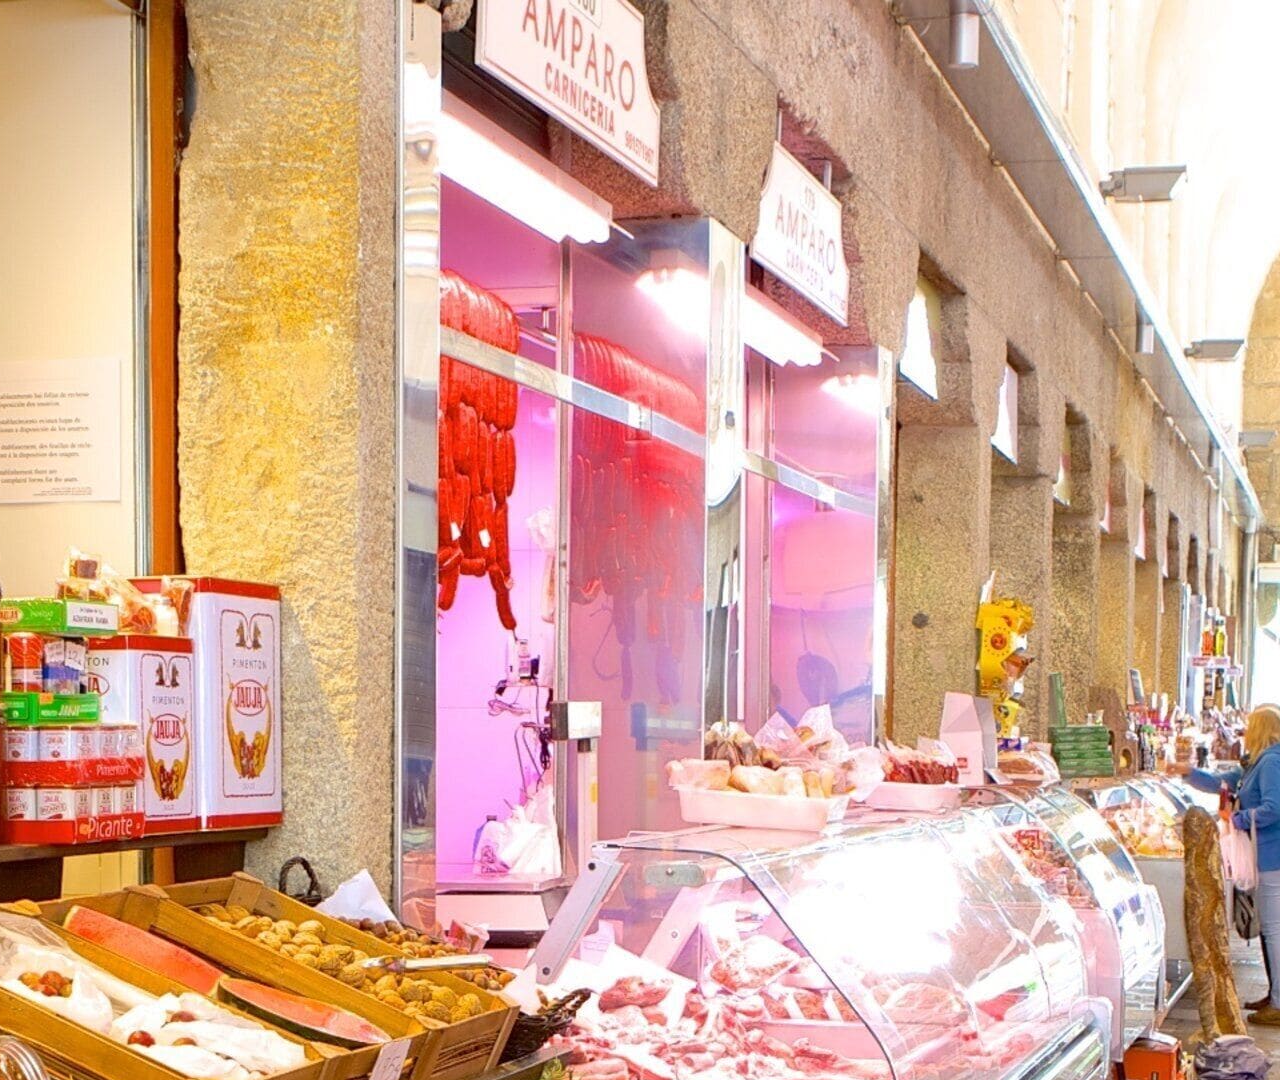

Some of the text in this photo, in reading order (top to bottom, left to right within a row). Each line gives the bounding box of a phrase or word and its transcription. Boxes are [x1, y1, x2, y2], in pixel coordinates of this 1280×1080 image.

[522, 0, 636, 112] AMPARO
[545, 62, 616, 137] CARNICERIA
[775, 194, 837, 275] AMPARO
[232, 658, 267, 670] PIMENTON
[152, 695, 185, 705] PIMENTON
[234, 686, 263, 709] JAUJA
[154, 719, 181, 740] JAUJA
[88, 816, 133, 839] Picante
